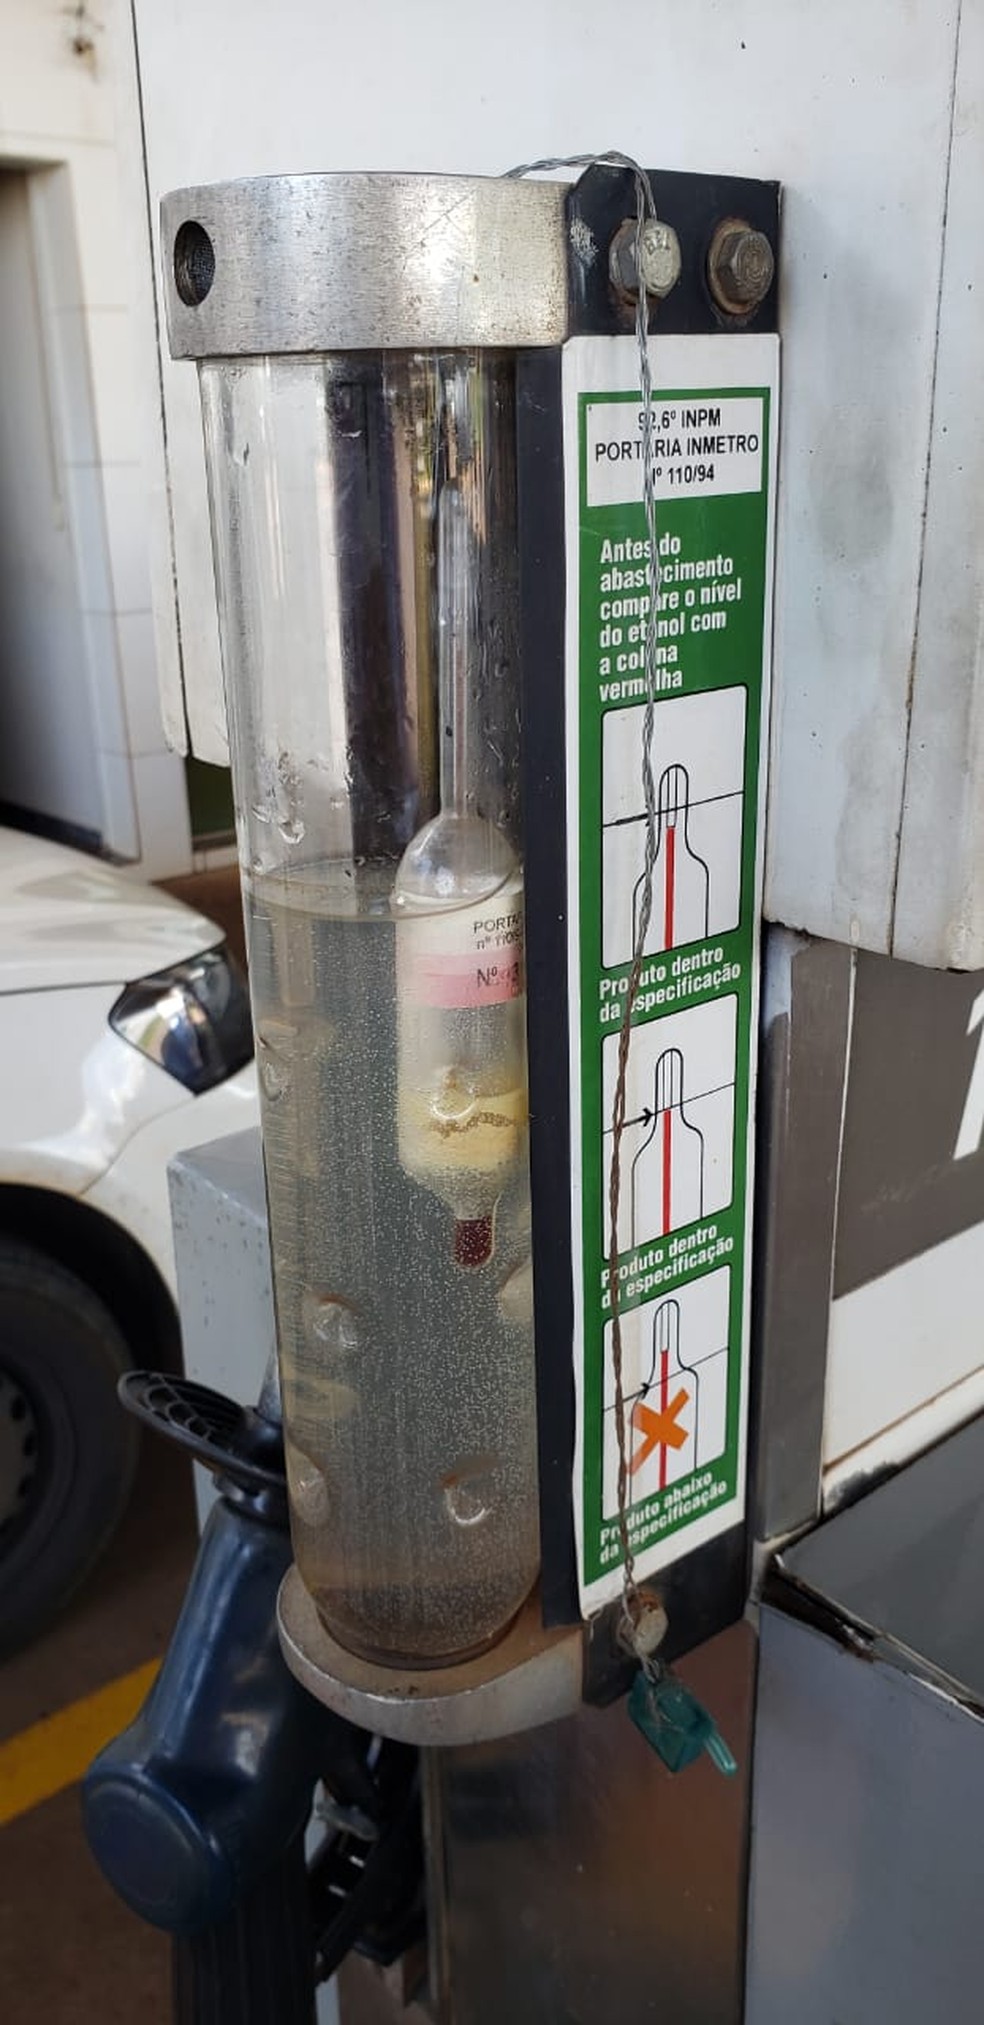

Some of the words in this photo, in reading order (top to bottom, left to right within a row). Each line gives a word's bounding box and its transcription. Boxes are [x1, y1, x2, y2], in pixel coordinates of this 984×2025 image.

[681, 408, 721, 428] INPM
[595, 437, 682, 463] PORTRIA
[687, 434, 759, 456] INMETRO
[667, 463, 715, 484] 110/94
[600, 538, 654, 563] Antes
[659, 531, 681, 556] do
[685, 588, 695, 607] o
[700, 577, 742, 604] nível
[600, 624, 623, 649] do
[628, 612, 685, 643] etnol
[690, 611, 727, 633] com
[600, 656, 610, 676] a
[616, 645, 678, 672] colna
[600, 964, 667, 1001] Prouto
[671, 947, 724, 977] dentro
[600, 1002, 621, 1023] da
[631, 962, 742, 1012] specificação
[601, 1248, 664, 1289] Poduto
[668, 1224, 717, 1258] dentro
[626, 1236, 734, 1297] especificação
[600, 1501, 661, 1547] Prduto
[663, 1471, 713, 1507] abaixo
[600, 1542, 619, 1564] da
